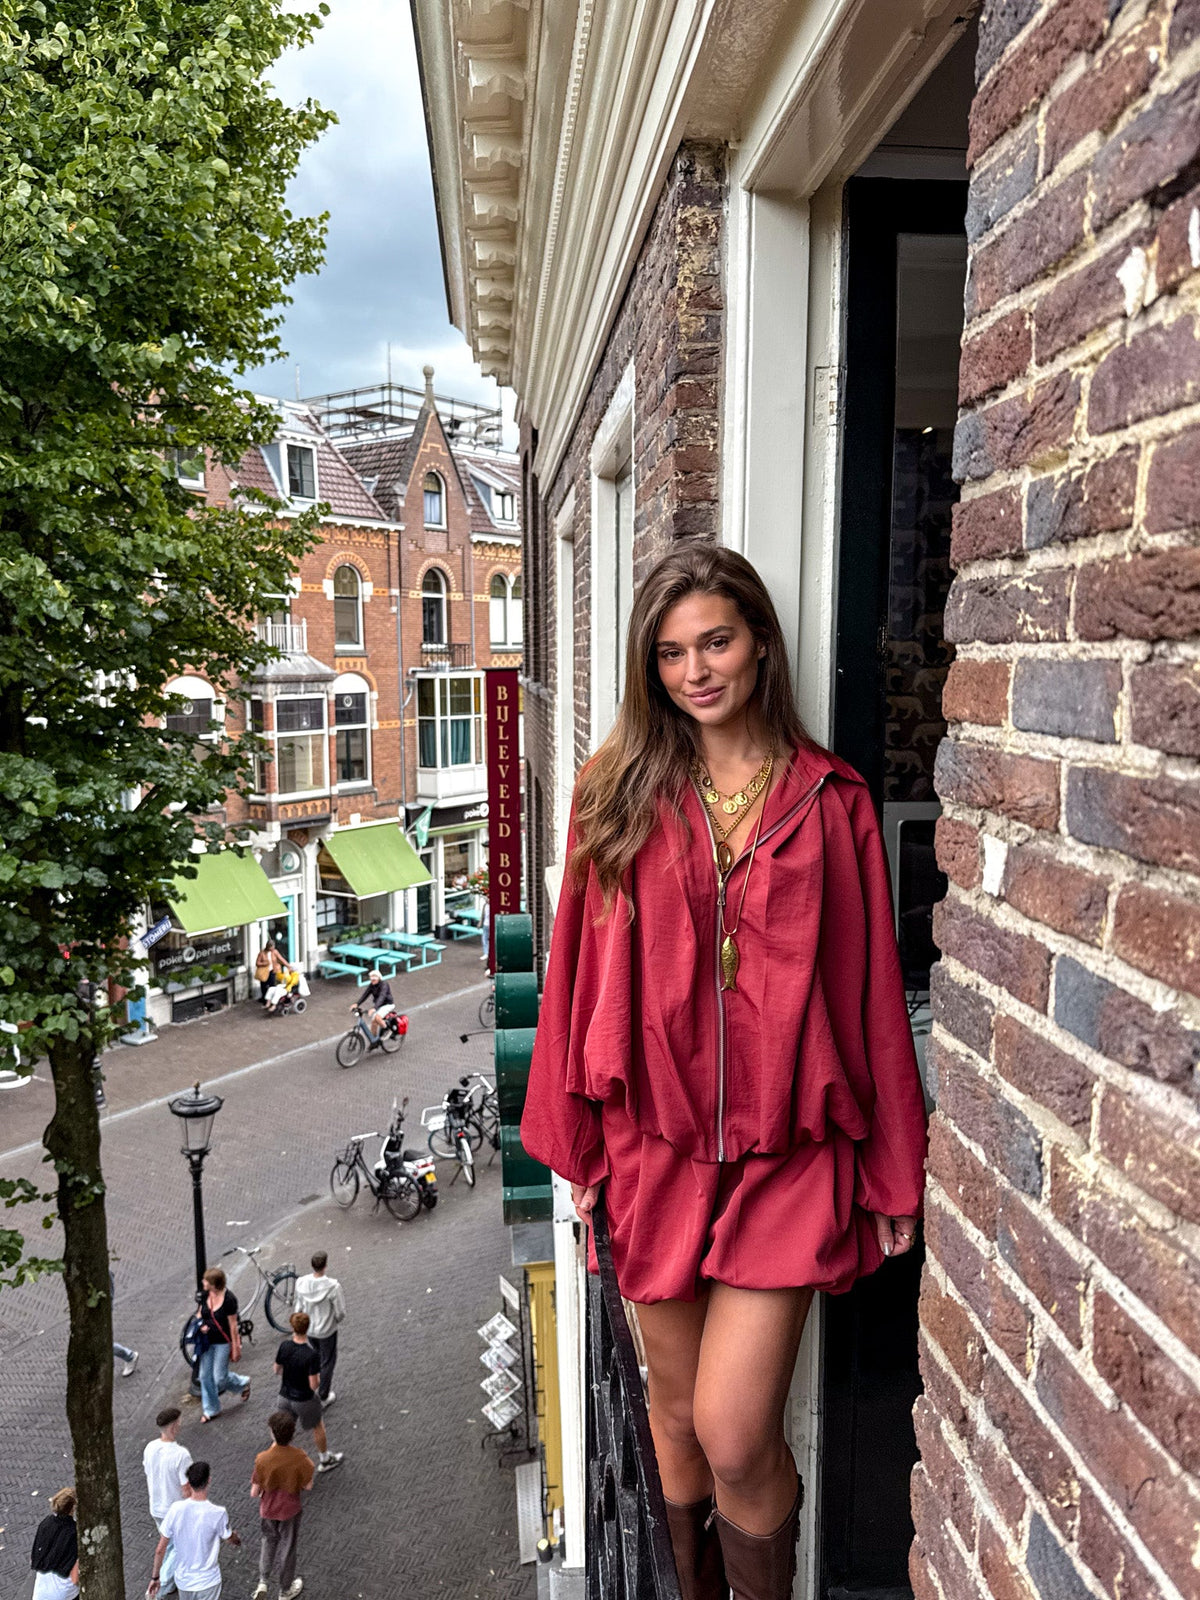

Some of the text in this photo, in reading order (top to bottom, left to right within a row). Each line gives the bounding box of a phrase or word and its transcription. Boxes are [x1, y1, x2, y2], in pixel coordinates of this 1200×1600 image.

[496, 685, 512, 914] BIJLEVELD BOE
[195, 942, 232, 960] perfect
